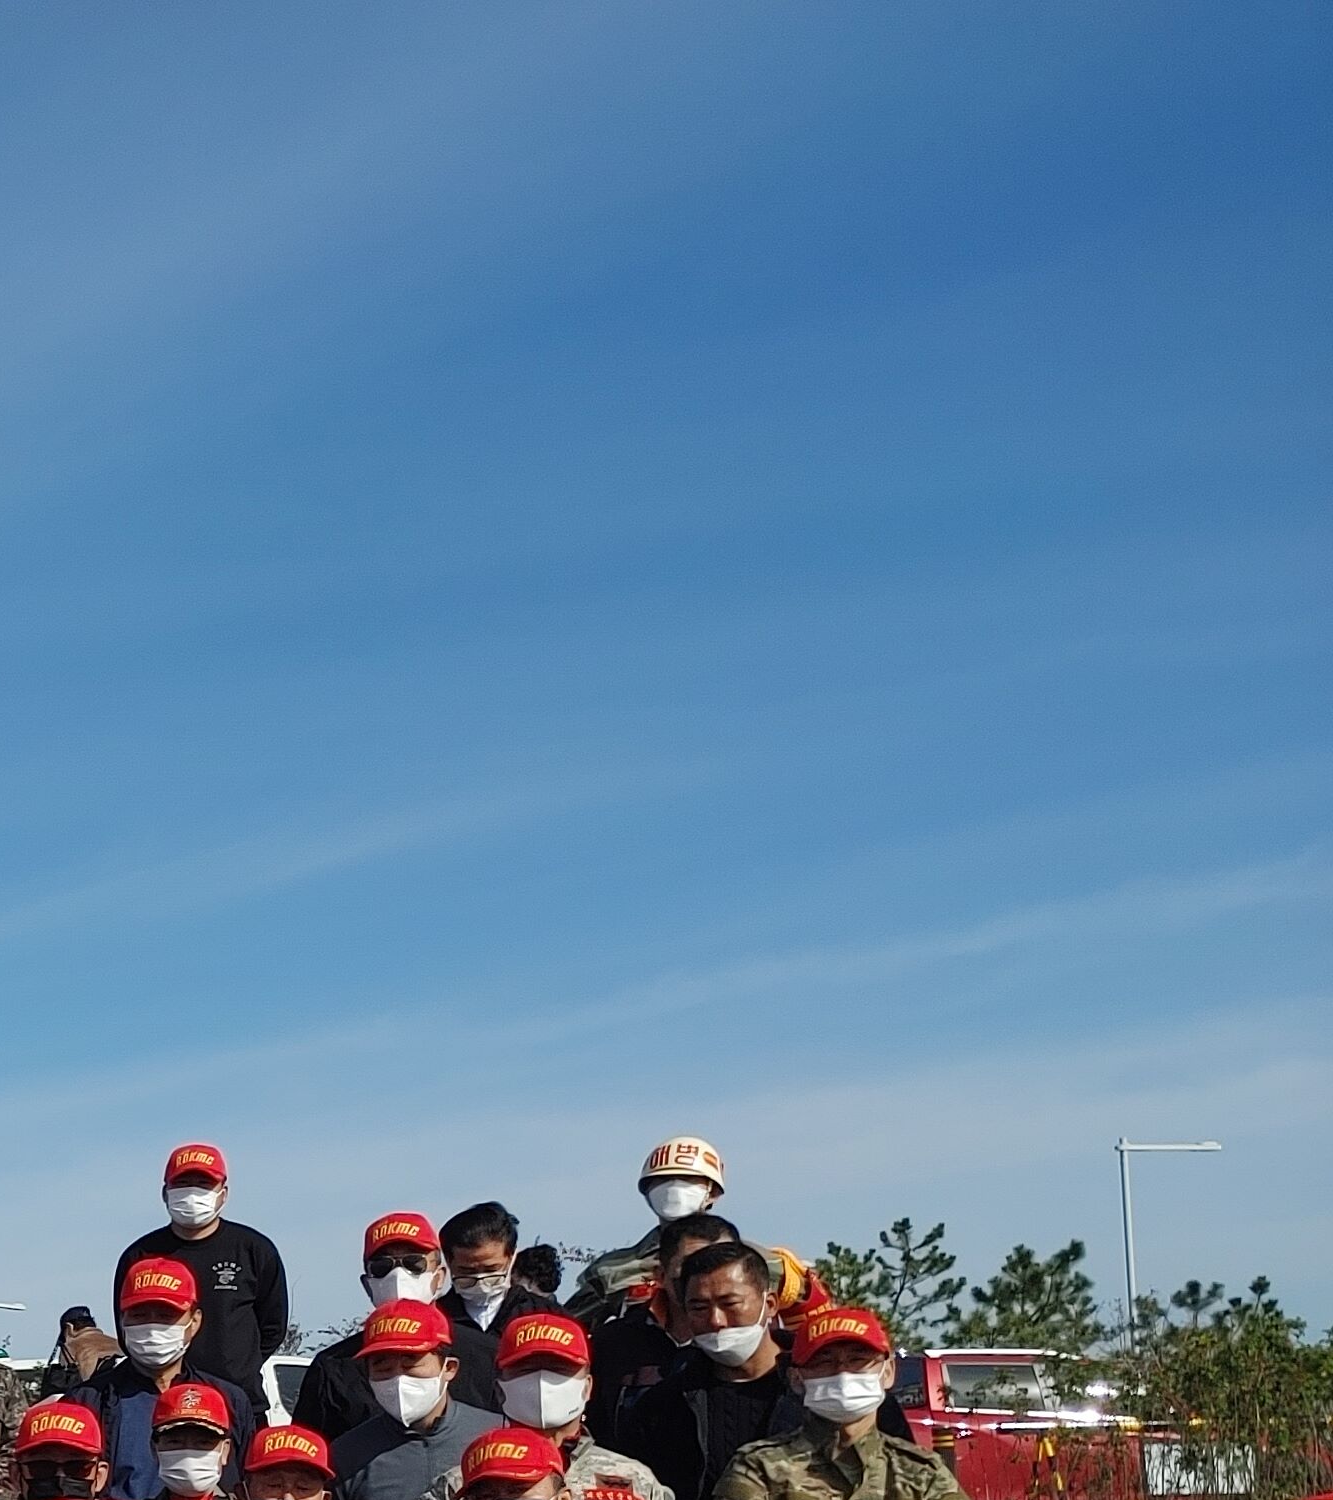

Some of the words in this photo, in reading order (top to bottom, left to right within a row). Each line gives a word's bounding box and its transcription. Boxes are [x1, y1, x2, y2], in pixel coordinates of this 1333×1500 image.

[176, 1151, 214, 1168] ROKMC
[372, 1221, 420, 1243] ROKMC
[133, 1273, 182, 1291] ROKMC
[369, 1317, 421, 1339] ROKMC
[515, 1325, 574, 1346] ROKMC
[807, 1318, 869, 1342] ROKMC
[30, 1414, 85, 1436] ROKMC
[263, 1435, 318, 1458] ROKMC
[467, 1443, 528, 1472] ROKMC
